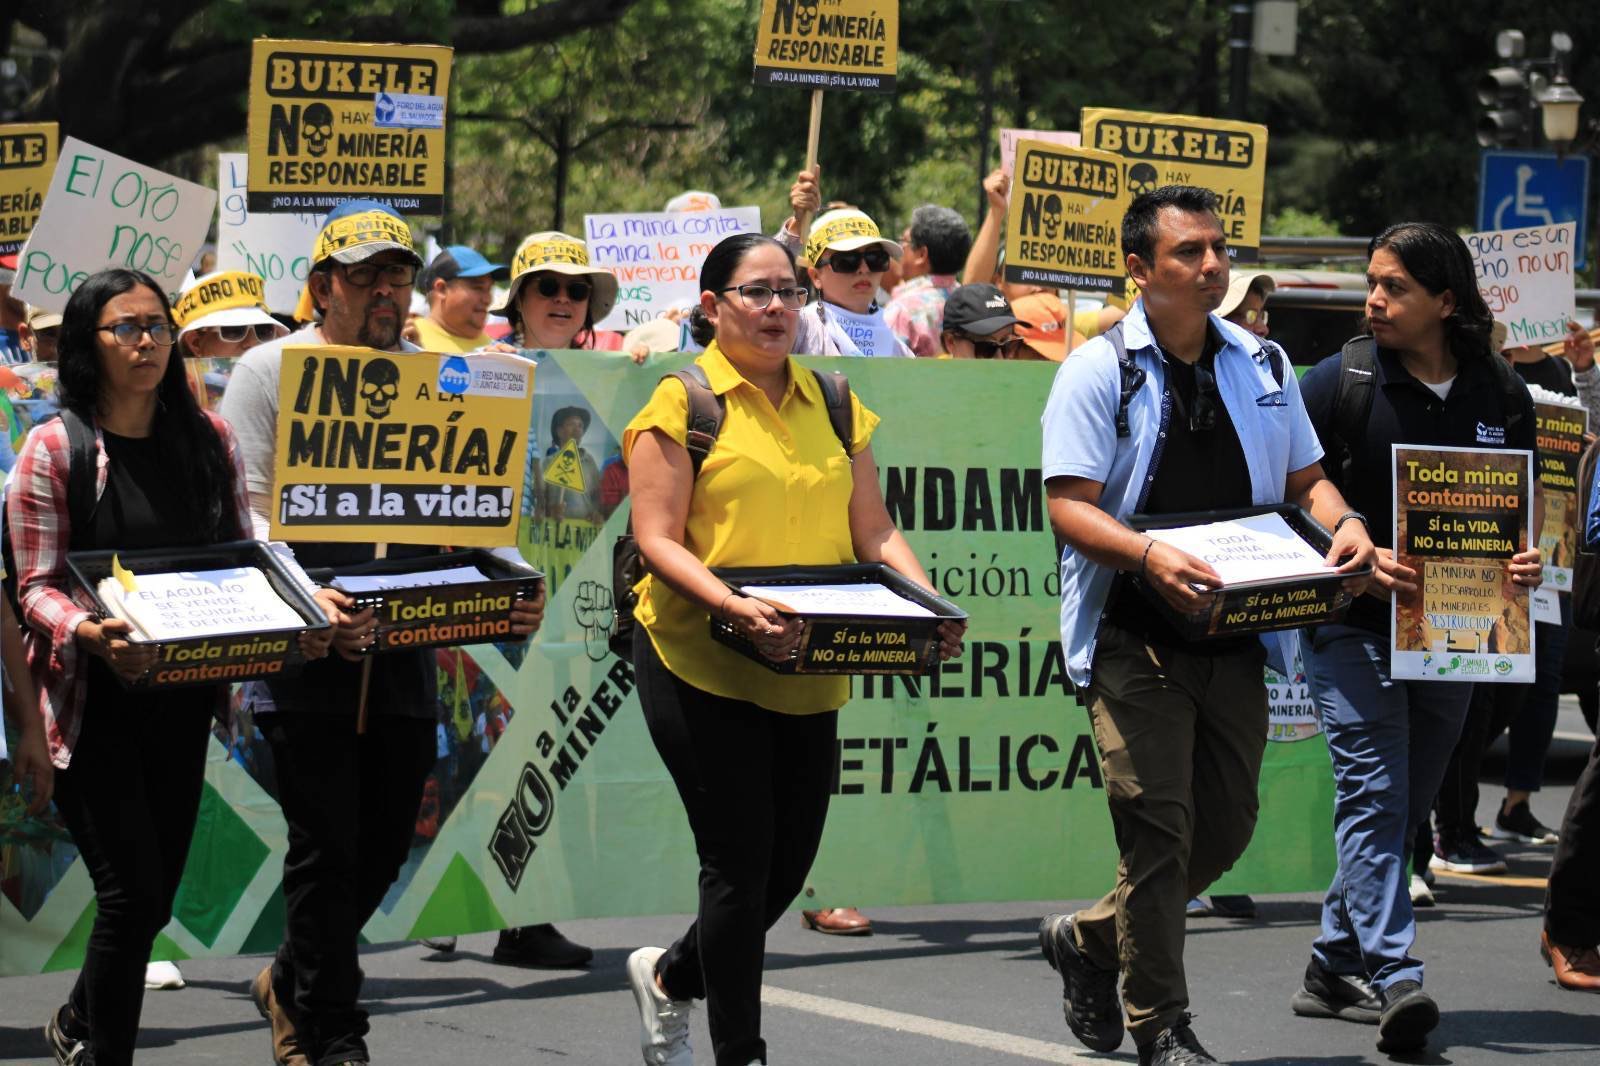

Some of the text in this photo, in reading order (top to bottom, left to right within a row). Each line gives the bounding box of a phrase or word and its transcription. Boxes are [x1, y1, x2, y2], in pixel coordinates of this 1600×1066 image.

[768, 39, 885, 67] RESPONSABLE
[271, 58, 432, 96] BUKELE
[341, 111, 370, 125] HAY
[337, 127, 430, 159] MINERÍA
[1100, 123, 1250, 165] BUKELE
[66, 155, 104, 199] El
[269, 161, 428, 187] RESPONSABLE
[1026, 155, 1118, 194] BUKELE
[1165, 171, 1192, 184] HAY
[294, 197, 300, 206] A
[302, 197, 314, 207] LA
[394, 199, 420, 209] VIDA!
[590, 217, 617, 240] La
[624, 215, 679, 237] mina
[1063, 221, 1116, 248] MINERÍA
[1513, 230, 1542, 248] es
[1546, 226, 1569, 244] un
[657, 241, 680, 260] la
[1019, 241, 1116, 270] RESPONSABLE
[1518, 255, 1541, 274] no
[1545, 251, 1569, 274] un
[199, 279, 234, 304] ORO
[237, 278, 257, 297] NO
[482, 371, 494, 380] RED
[494, 372, 525, 382] NACIONAL
[416, 383, 430, 400] A
[1546, 416, 1582, 436] mina
[287, 411, 517, 477] MINERÍA!
[1406, 460, 1518, 486] Toda mina
[1544, 459, 1566, 472] VIDA
[281, 483, 514, 524] ¡Sí a la vida!
[1407, 488, 1519, 509] contamina
[1428, 516, 1500, 534] SÍ a la VIDA
[1414, 536, 1514, 552] NO a la MINERIA
[1426, 566, 1496, 582] LA MINERIA NO
[140, 584, 244, 601] EL AGUA NO
[1246, 588, 1317, 607] SÍ a la VIDA
[1425, 584, 1438, 594] ES
[388, 592, 511, 622] Toda mina
[1226, 603, 1328, 624] NO a la MINERIA
[1426, 601, 1491, 612] LA MINERIA ES
[388, 616, 511, 646] contamina
[833, 627, 906, 644] SÍ a la VIDA
[163, 637, 289, 663] Toda mina
[813, 650, 916, 663] NO a la MINERIA
[156, 657, 284, 684] contamina
[488, 685, 582, 894] NO a la
